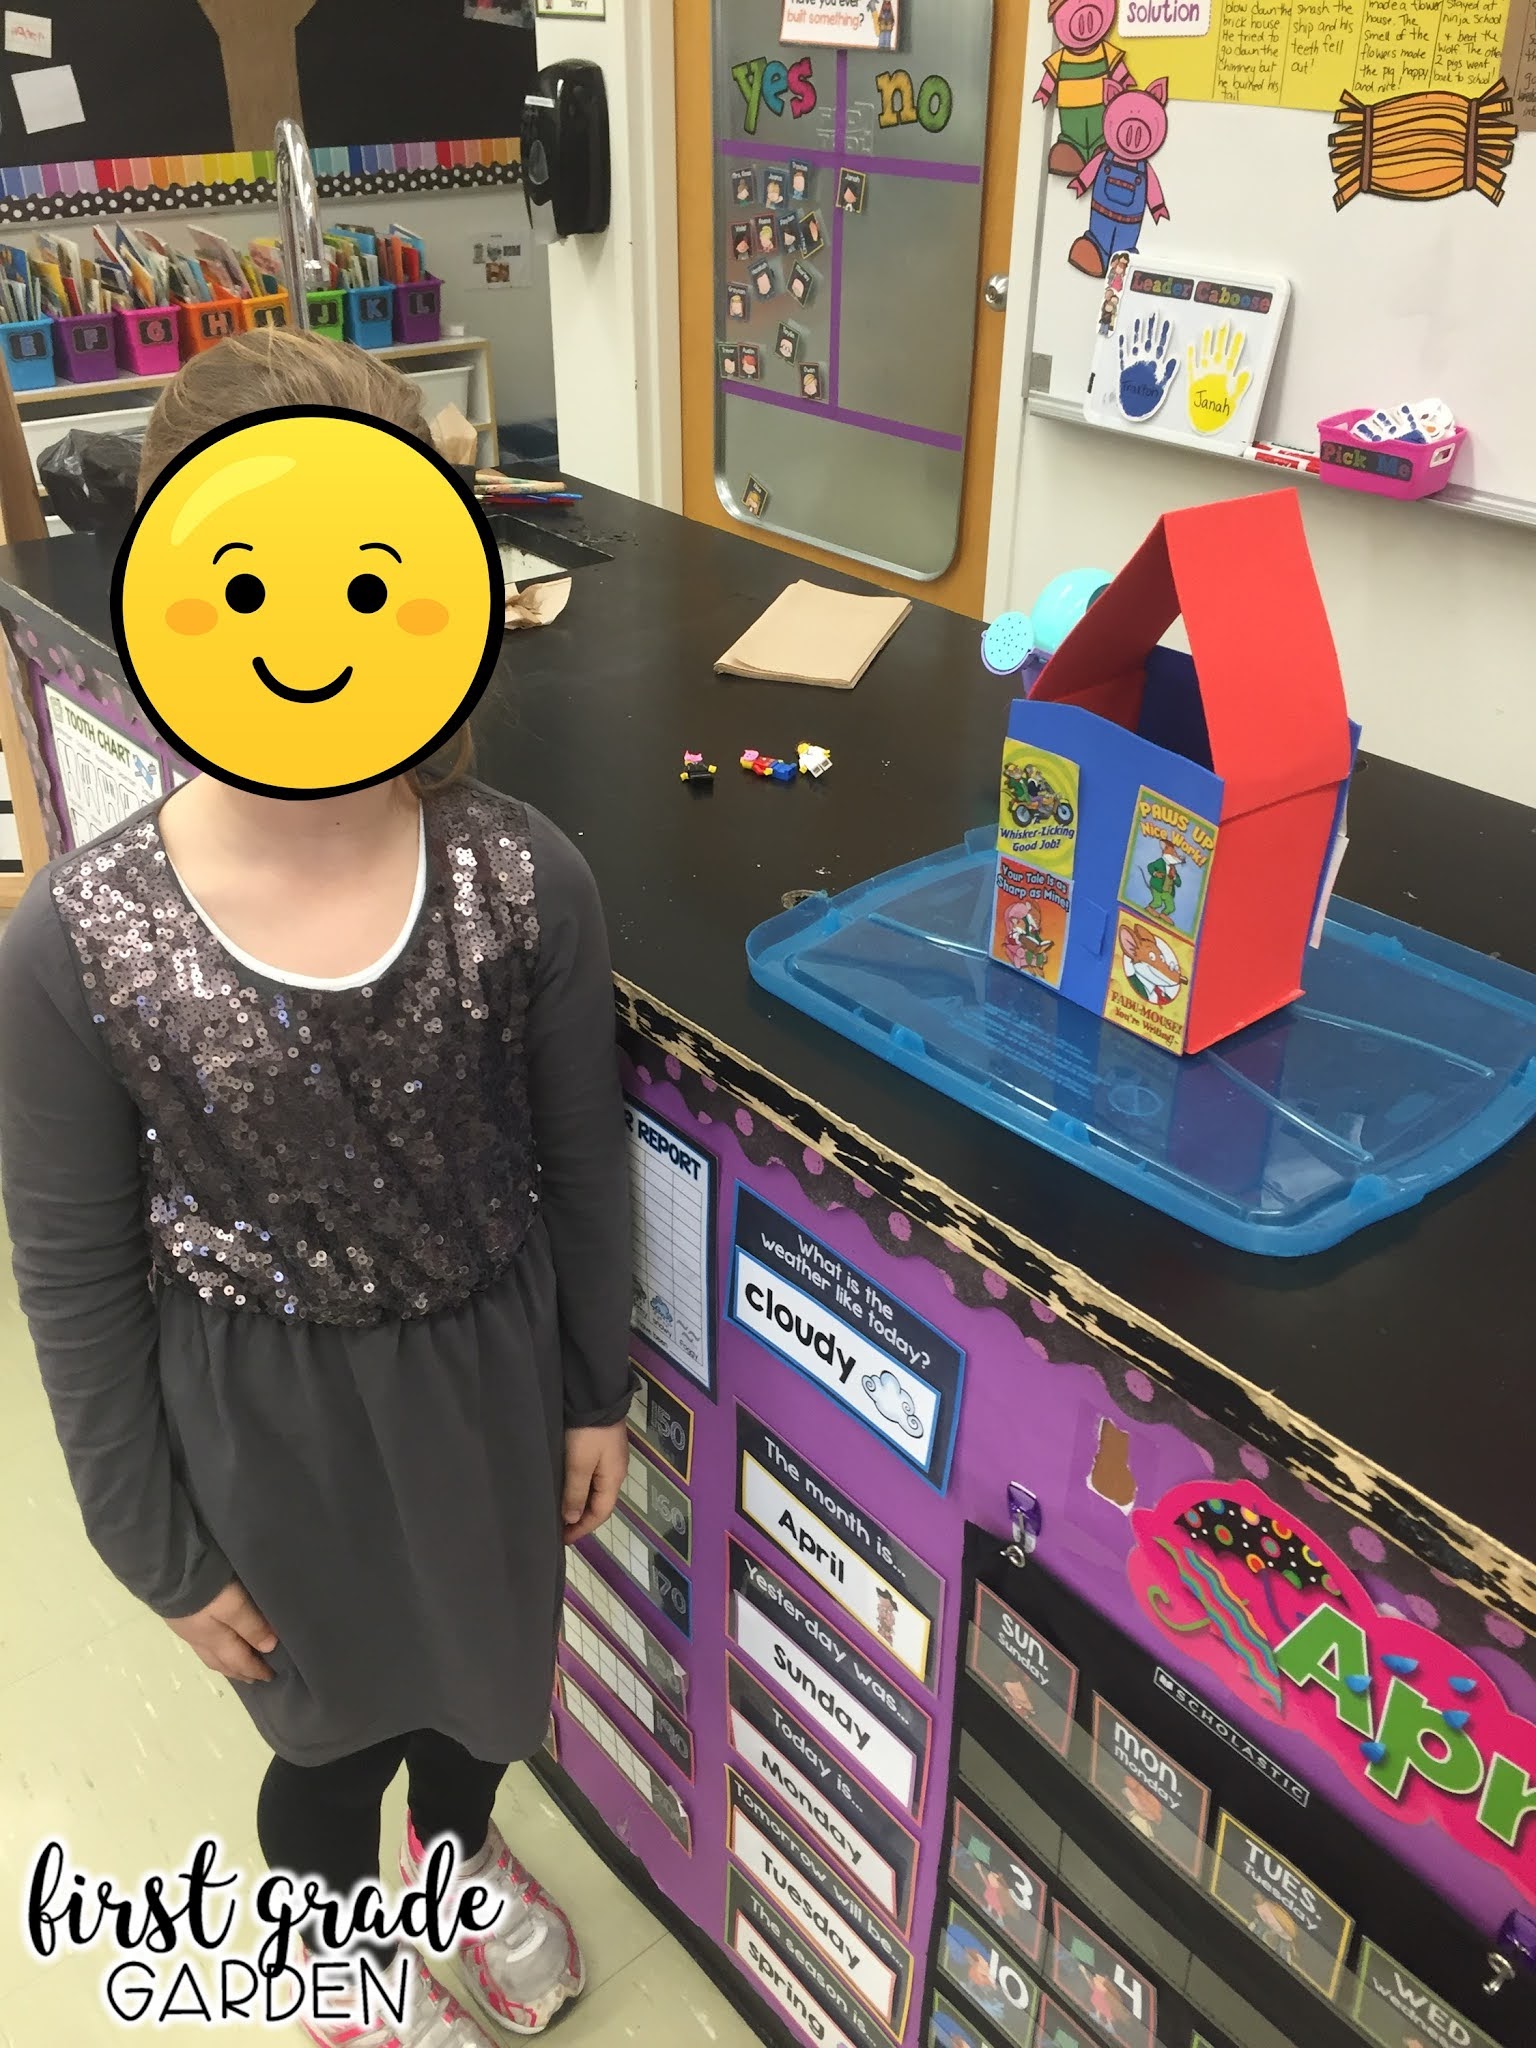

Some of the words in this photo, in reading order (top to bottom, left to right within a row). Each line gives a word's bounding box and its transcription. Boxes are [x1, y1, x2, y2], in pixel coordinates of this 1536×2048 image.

[787, 10, 807, 22] built
[808, 11, 865, 30] something?
[1127, 0, 1200, 24] solution
[1223, 15, 1246, 28] brick
[1251, 14, 1280, 30] house
[1251, 4, 1276, 16] down
[1292, 18, 1313, 38] ship
[1318, 18, 1337, 32] and
[1339, 17, 1353, 33] his
[1333, 0, 1353, 15] the
[1369, 0, 1398, 11] made
[1443, 14, 1470, 26] ninja
[1483, 0, 1498, 11] at
[1221, 46, 1232, 59] go
[1234, 45, 1259, 57] down
[1260, 45, 1279, 58] the
[1222, 30, 1235, 42] He
[1239, 31, 1264, 44] tried
[1267, 30, 1280, 43] to
[1291, 37, 1318, 56] teeth
[1322, 34, 1344, 55] fell
[1361, 42, 1397, 60] flowers
[1400, 48, 1426, 59] made
[1395, 28, 1406, 41] of
[1409, 26, 1429, 42] the
[1217, 75, 1228, 89] he
[1267, 77, 1279, 93] his
[1258, 60, 1278, 73] but
[1360, 63, 1378, 78] the
[1401, 61, 1429, 81] happy
[1434, 55, 1443, 66] 2
[1447, 59, 1462, 71] pigs
[731, 56, 817, 135] yes
[875, 69, 953, 133] no
[1354, 81, 1374, 93] and
[366, 298, 384, 319] K
[416, 294, 431, 314] L
[1132, 270, 1192, 299] Leader
[1197, 281, 1271, 312] Caboose
[208, 313, 229, 336] H
[1193, 390, 1231, 416] Janah
[1322, 443, 1367, 469] Pick
[64, 706, 96, 743] TOOTH
[97, 729, 131, 768] CHART
[1012, 841, 1037, 852] Good
[1140, 801, 1190, 832] PAWS
[1192, 826, 1214, 850] UP
[1141, 821, 1168, 840] Nice
[1172, 831, 1208, 868] Work!
[996, 873, 1027, 900] Sharp
[1029, 888, 1042, 899] as
[1001, 862, 1023, 882] Your
[1025, 871, 1045, 885] Tale
[1056, 881, 1068, 895] as
[638, 1119, 702, 1181] REPORT
[798, 1234, 843, 1280] What
[846, 1272, 860, 1295] is
[865, 1286, 893, 1321] the
[761, 1232, 831, 1291] weather
[836, 1283, 863, 1319] like
[868, 1311, 931, 1369] today?
[745, 1282, 857, 1384] cloudy
[650, 1399, 686, 1451] 150
[651, 1485, 686, 1536] 160
[764, 1436, 800, 1482] The
[805, 1477, 870, 1546] month
[778, 1509, 845, 1584] April
[652, 1565, 687, 1615] 170
[745, 1559, 847, 1663] Yesterday
[773, 1644, 871, 1751] Sunday
[656, 1710, 689, 1760] 190
[772, 1708, 832, 1778] Today
[1176, 1689, 1304, 1800] SCHOLASTIC
[762, 1751, 862, 1865] Monday
[734, 1780, 827, 1882] Tomorrow
[833, 1885, 863, 1923] will
[1009, 1863, 1034, 1911] 3
[1245, 1838, 1322, 1921] TUES.
[761, 1851, 860, 1970] Tuesday
[750, 1895, 780, 1939] The
[785, 1938, 848, 2014] season
[748, 1941, 825, 2041] spring
[989, 1948, 1030, 2010] 10
[1113, 1963, 1142, 2020] 4
